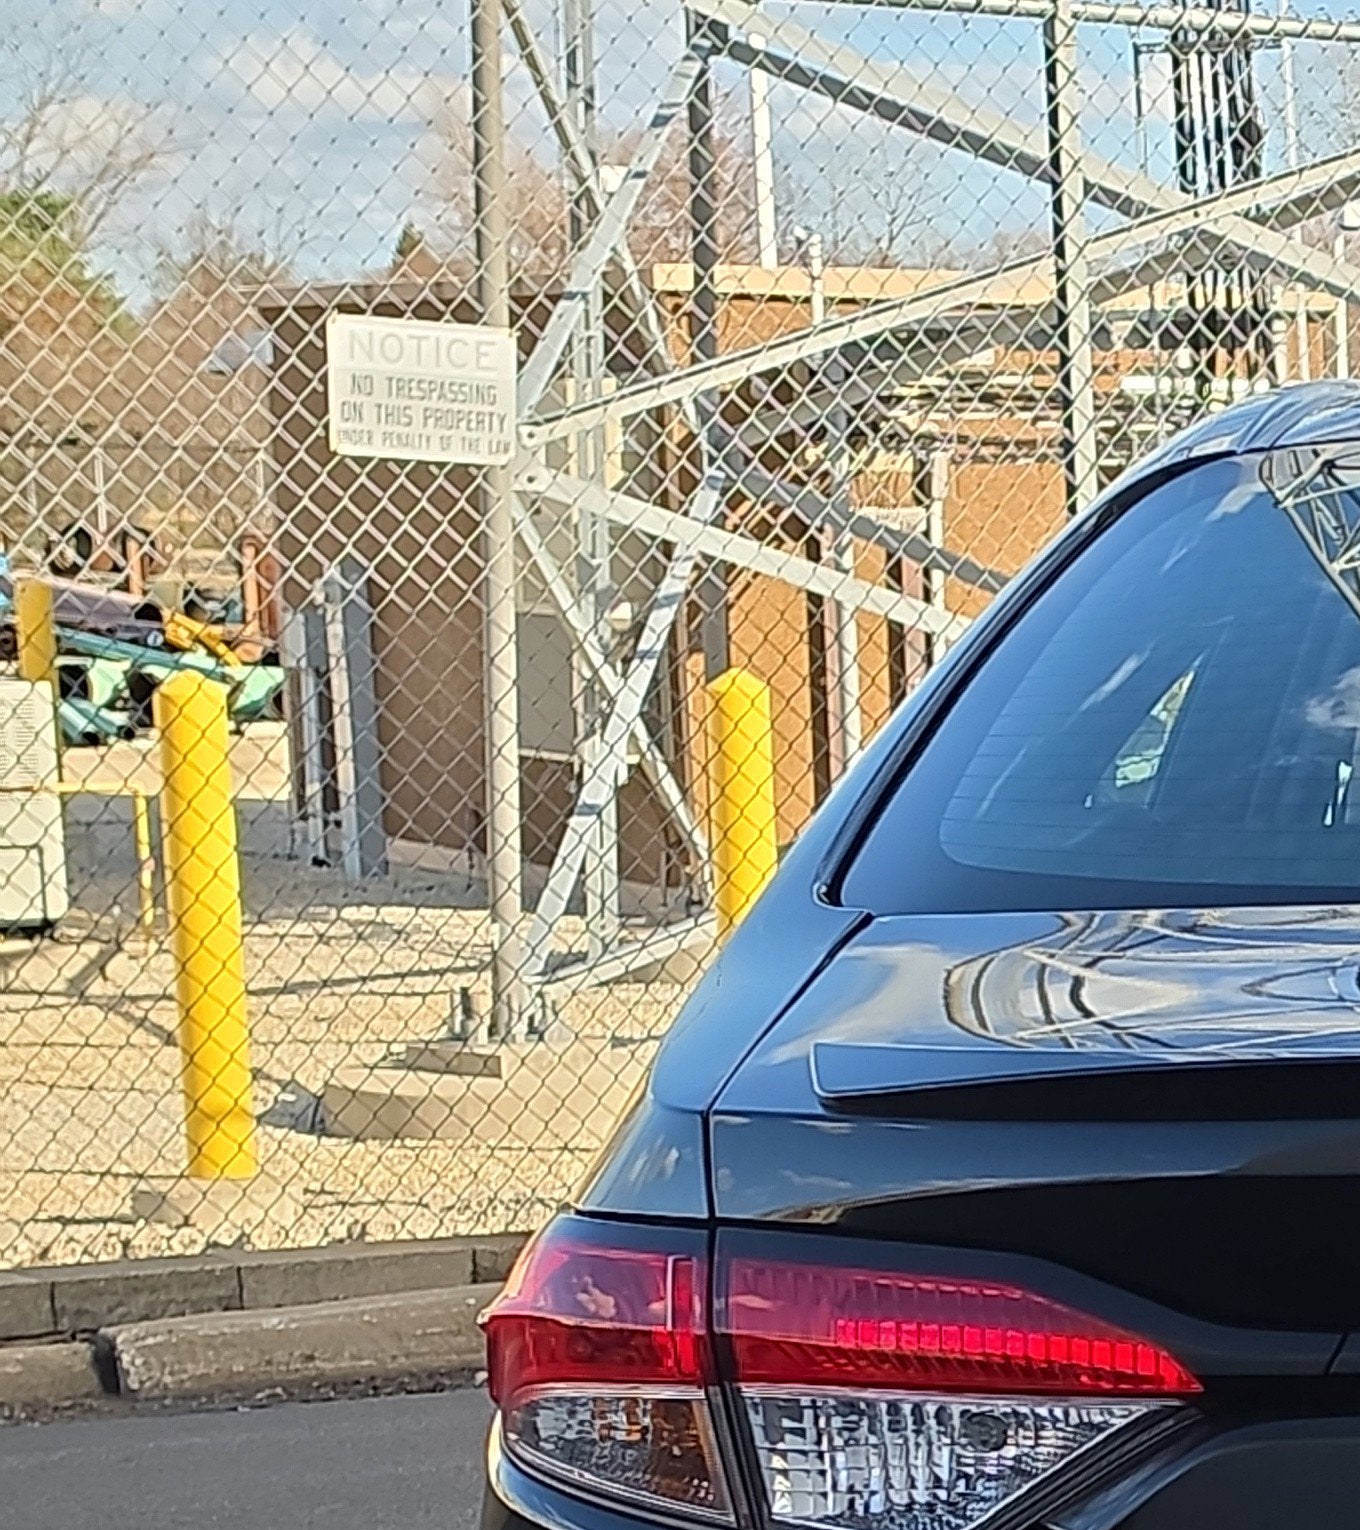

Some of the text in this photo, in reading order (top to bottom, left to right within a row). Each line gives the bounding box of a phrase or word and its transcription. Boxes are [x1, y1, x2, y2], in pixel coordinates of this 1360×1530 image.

[349, 330, 498, 371] NOTICE
[349, 373, 498, 406] NO TRESPASSING
[340, 400, 507, 434] ON THIS PROPERTY
[338, 428, 512, 456] UNDER PENALTY OF THE LAW
